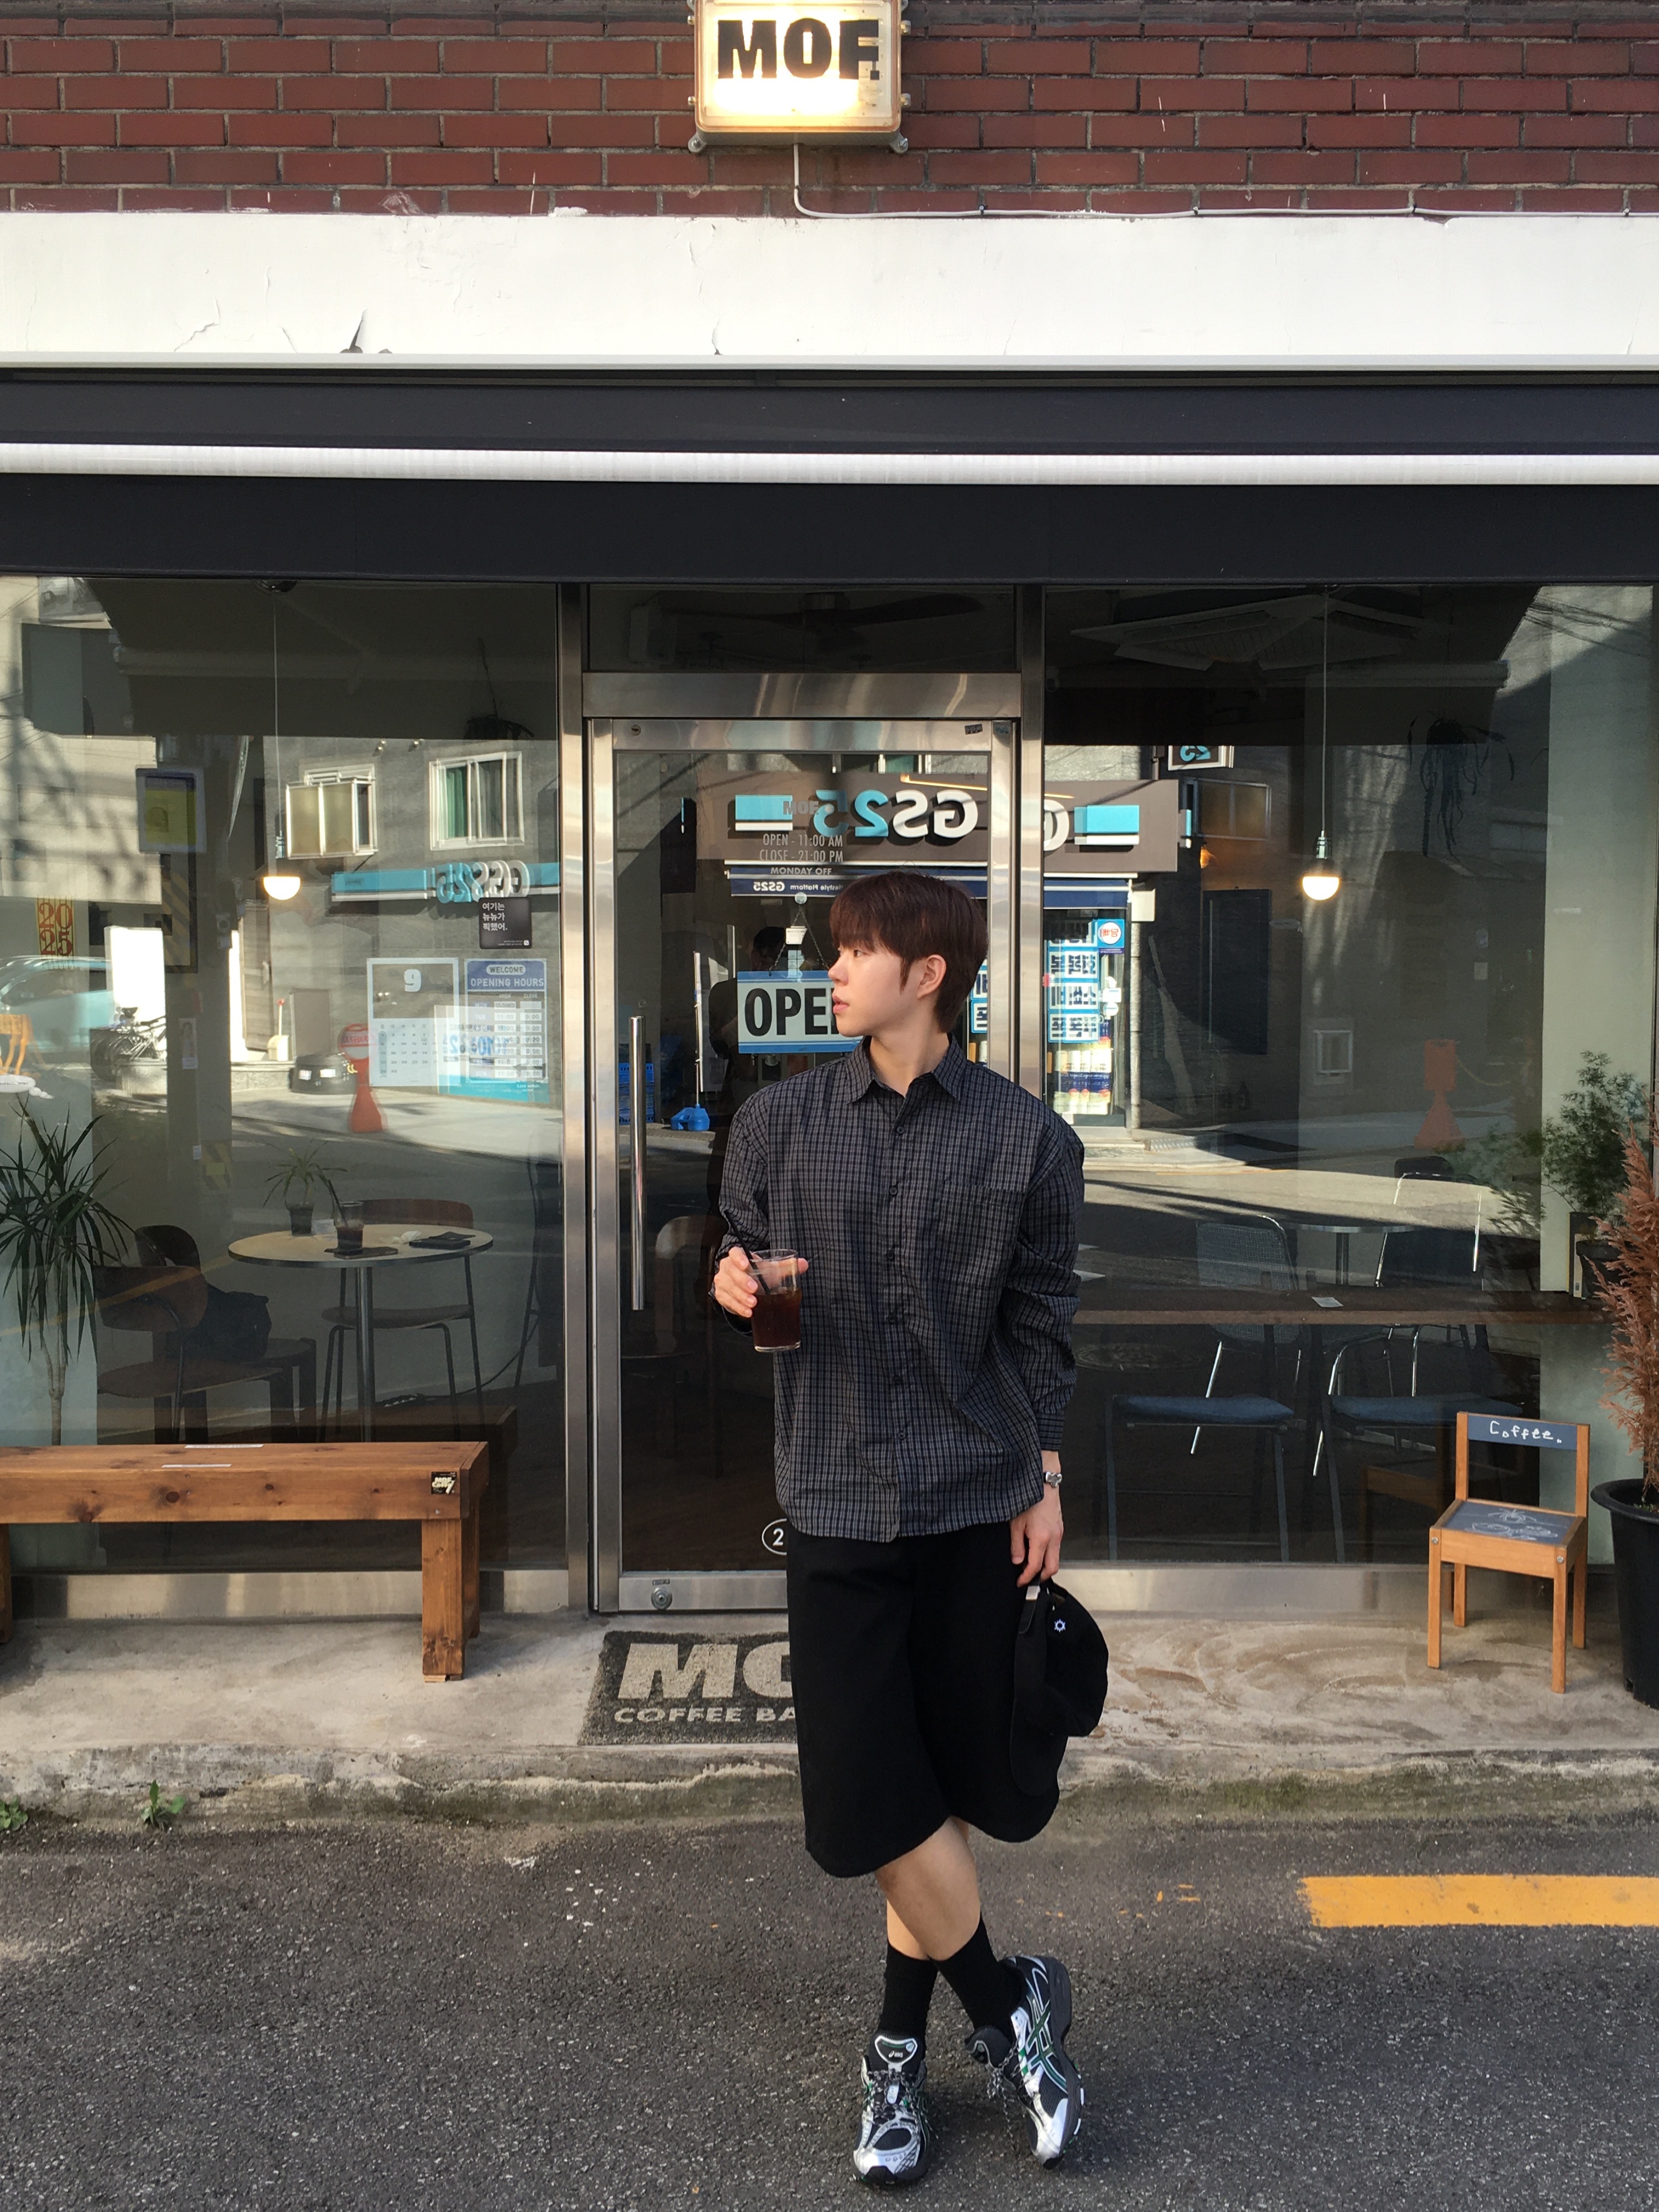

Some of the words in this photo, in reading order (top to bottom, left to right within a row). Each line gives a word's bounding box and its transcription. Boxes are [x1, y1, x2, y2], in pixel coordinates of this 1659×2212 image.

[763, 833, 788, 846] OPEN
[799, 834, 825, 847] 11:00
[828, 835, 843, 847] AM
[759, 849, 788, 862] CLOSE
[798, 850, 826, 862] 21:00
[829, 851, 844, 863] PM
[482, 902, 505, 911] 여기는
[39, 902, 73, 929] 20
[40, 929, 74, 956] 25
[404, 969, 421, 992] 9
[470, 978, 511, 987] OPENING
[514, 978, 544, 987] HOURS
[772, 1528, 784, 1546] 2
[618, 1642, 793, 1699] MO
[614, 1706, 743, 1723] COFFEE
[756, 1706, 797, 1722] BA
